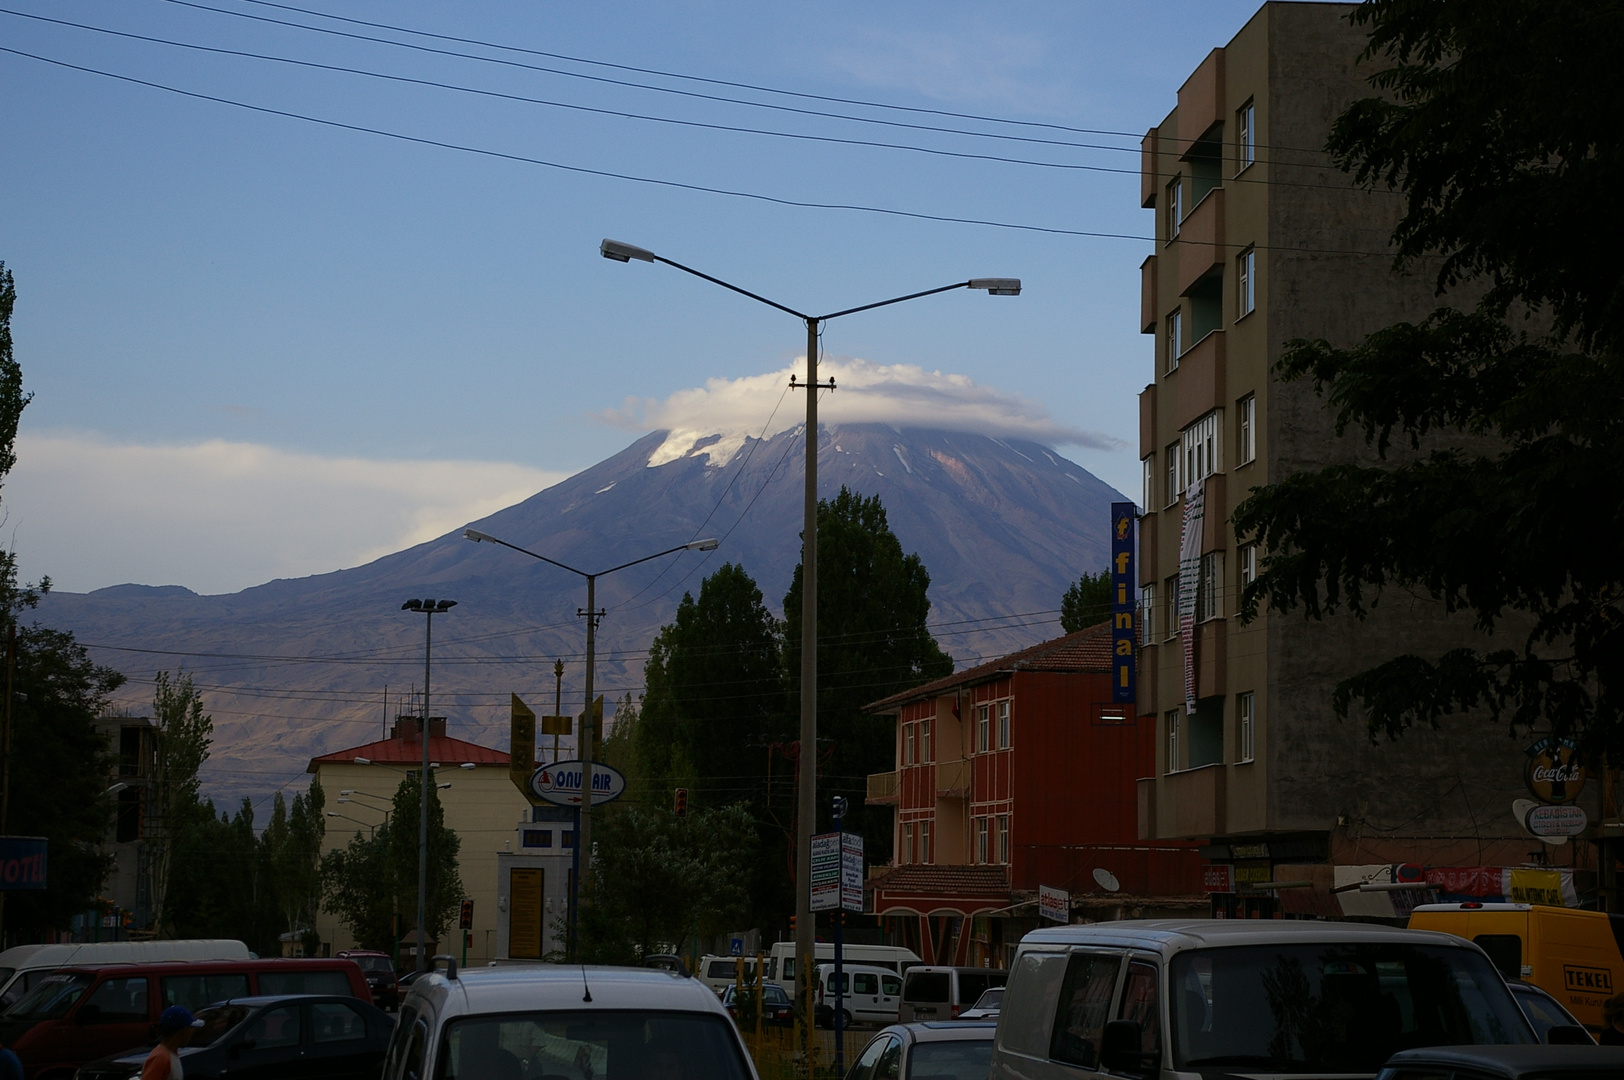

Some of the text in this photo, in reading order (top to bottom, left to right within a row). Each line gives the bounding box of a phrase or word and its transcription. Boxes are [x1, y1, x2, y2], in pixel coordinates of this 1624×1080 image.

[1115, 551, 1132, 688] final
[556, 771, 611, 790] ONU AIR
[1566, 970, 1611, 989] TEKEL
